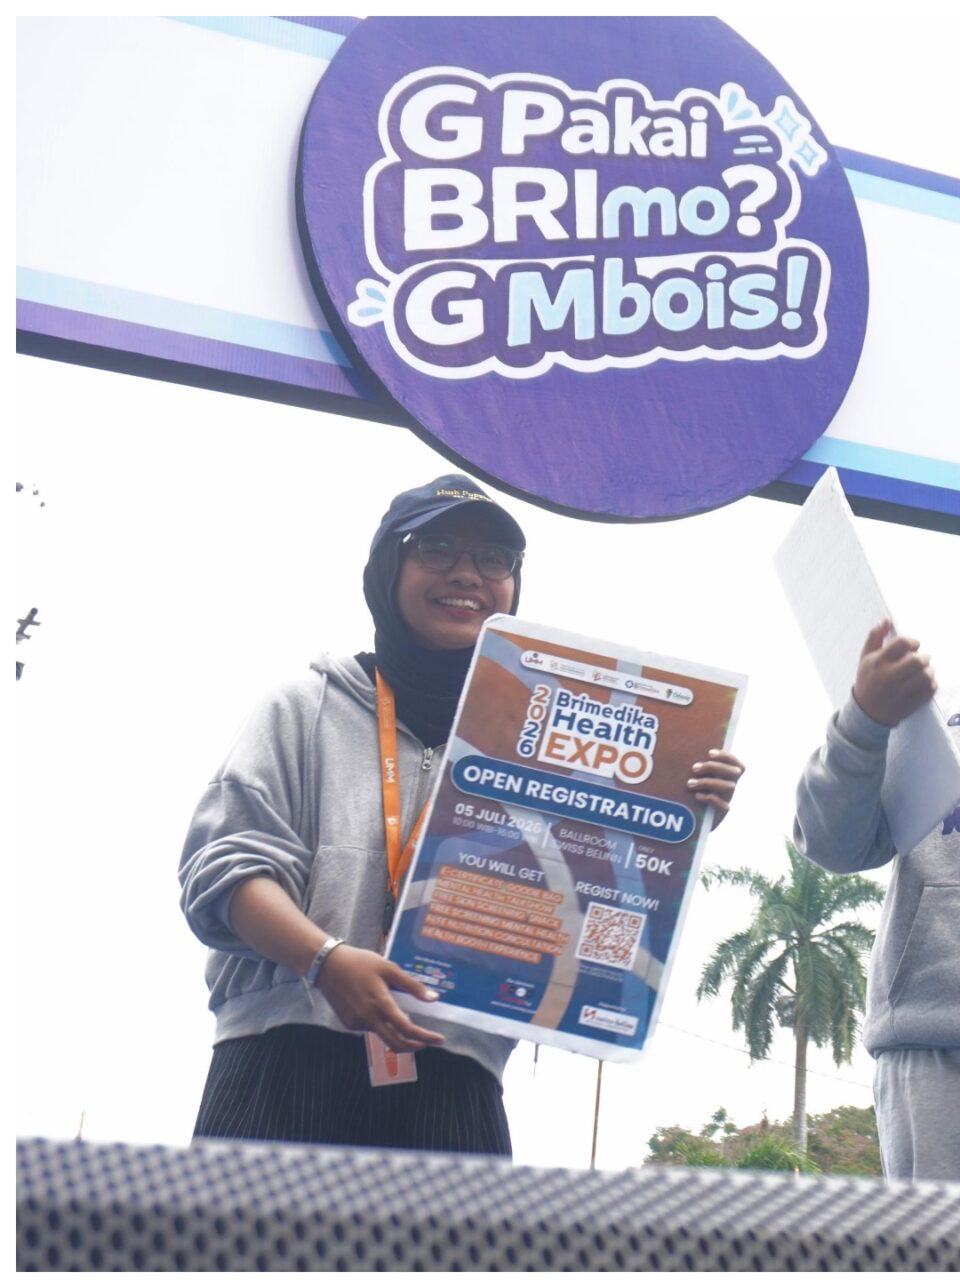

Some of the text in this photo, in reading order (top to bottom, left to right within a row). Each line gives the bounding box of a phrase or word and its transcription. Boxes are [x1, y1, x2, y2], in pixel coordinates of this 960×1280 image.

[400, 84, 708, 160] G Pakai
[403, 164, 777, 251] BRImo?
[405, 255, 809, 347] G Mbois!
[517, 686, 549, 756] 2026
[552, 708, 653, 749] Health
[556, 691, 657, 729] Brimedika
[543, 730, 649, 780] EXPO
[454, 802, 475, 817] 05
[474, 807, 506, 824] JULI
[461, 764, 684, 833] OPEN REGISTRATION
[558, 828, 617, 850] BALLROOM
[456, 851, 544, 883] YOU WILL GET
[633, 853, 673, 875] 50K
[574, 880, 659, 911] REGIST NOW!
